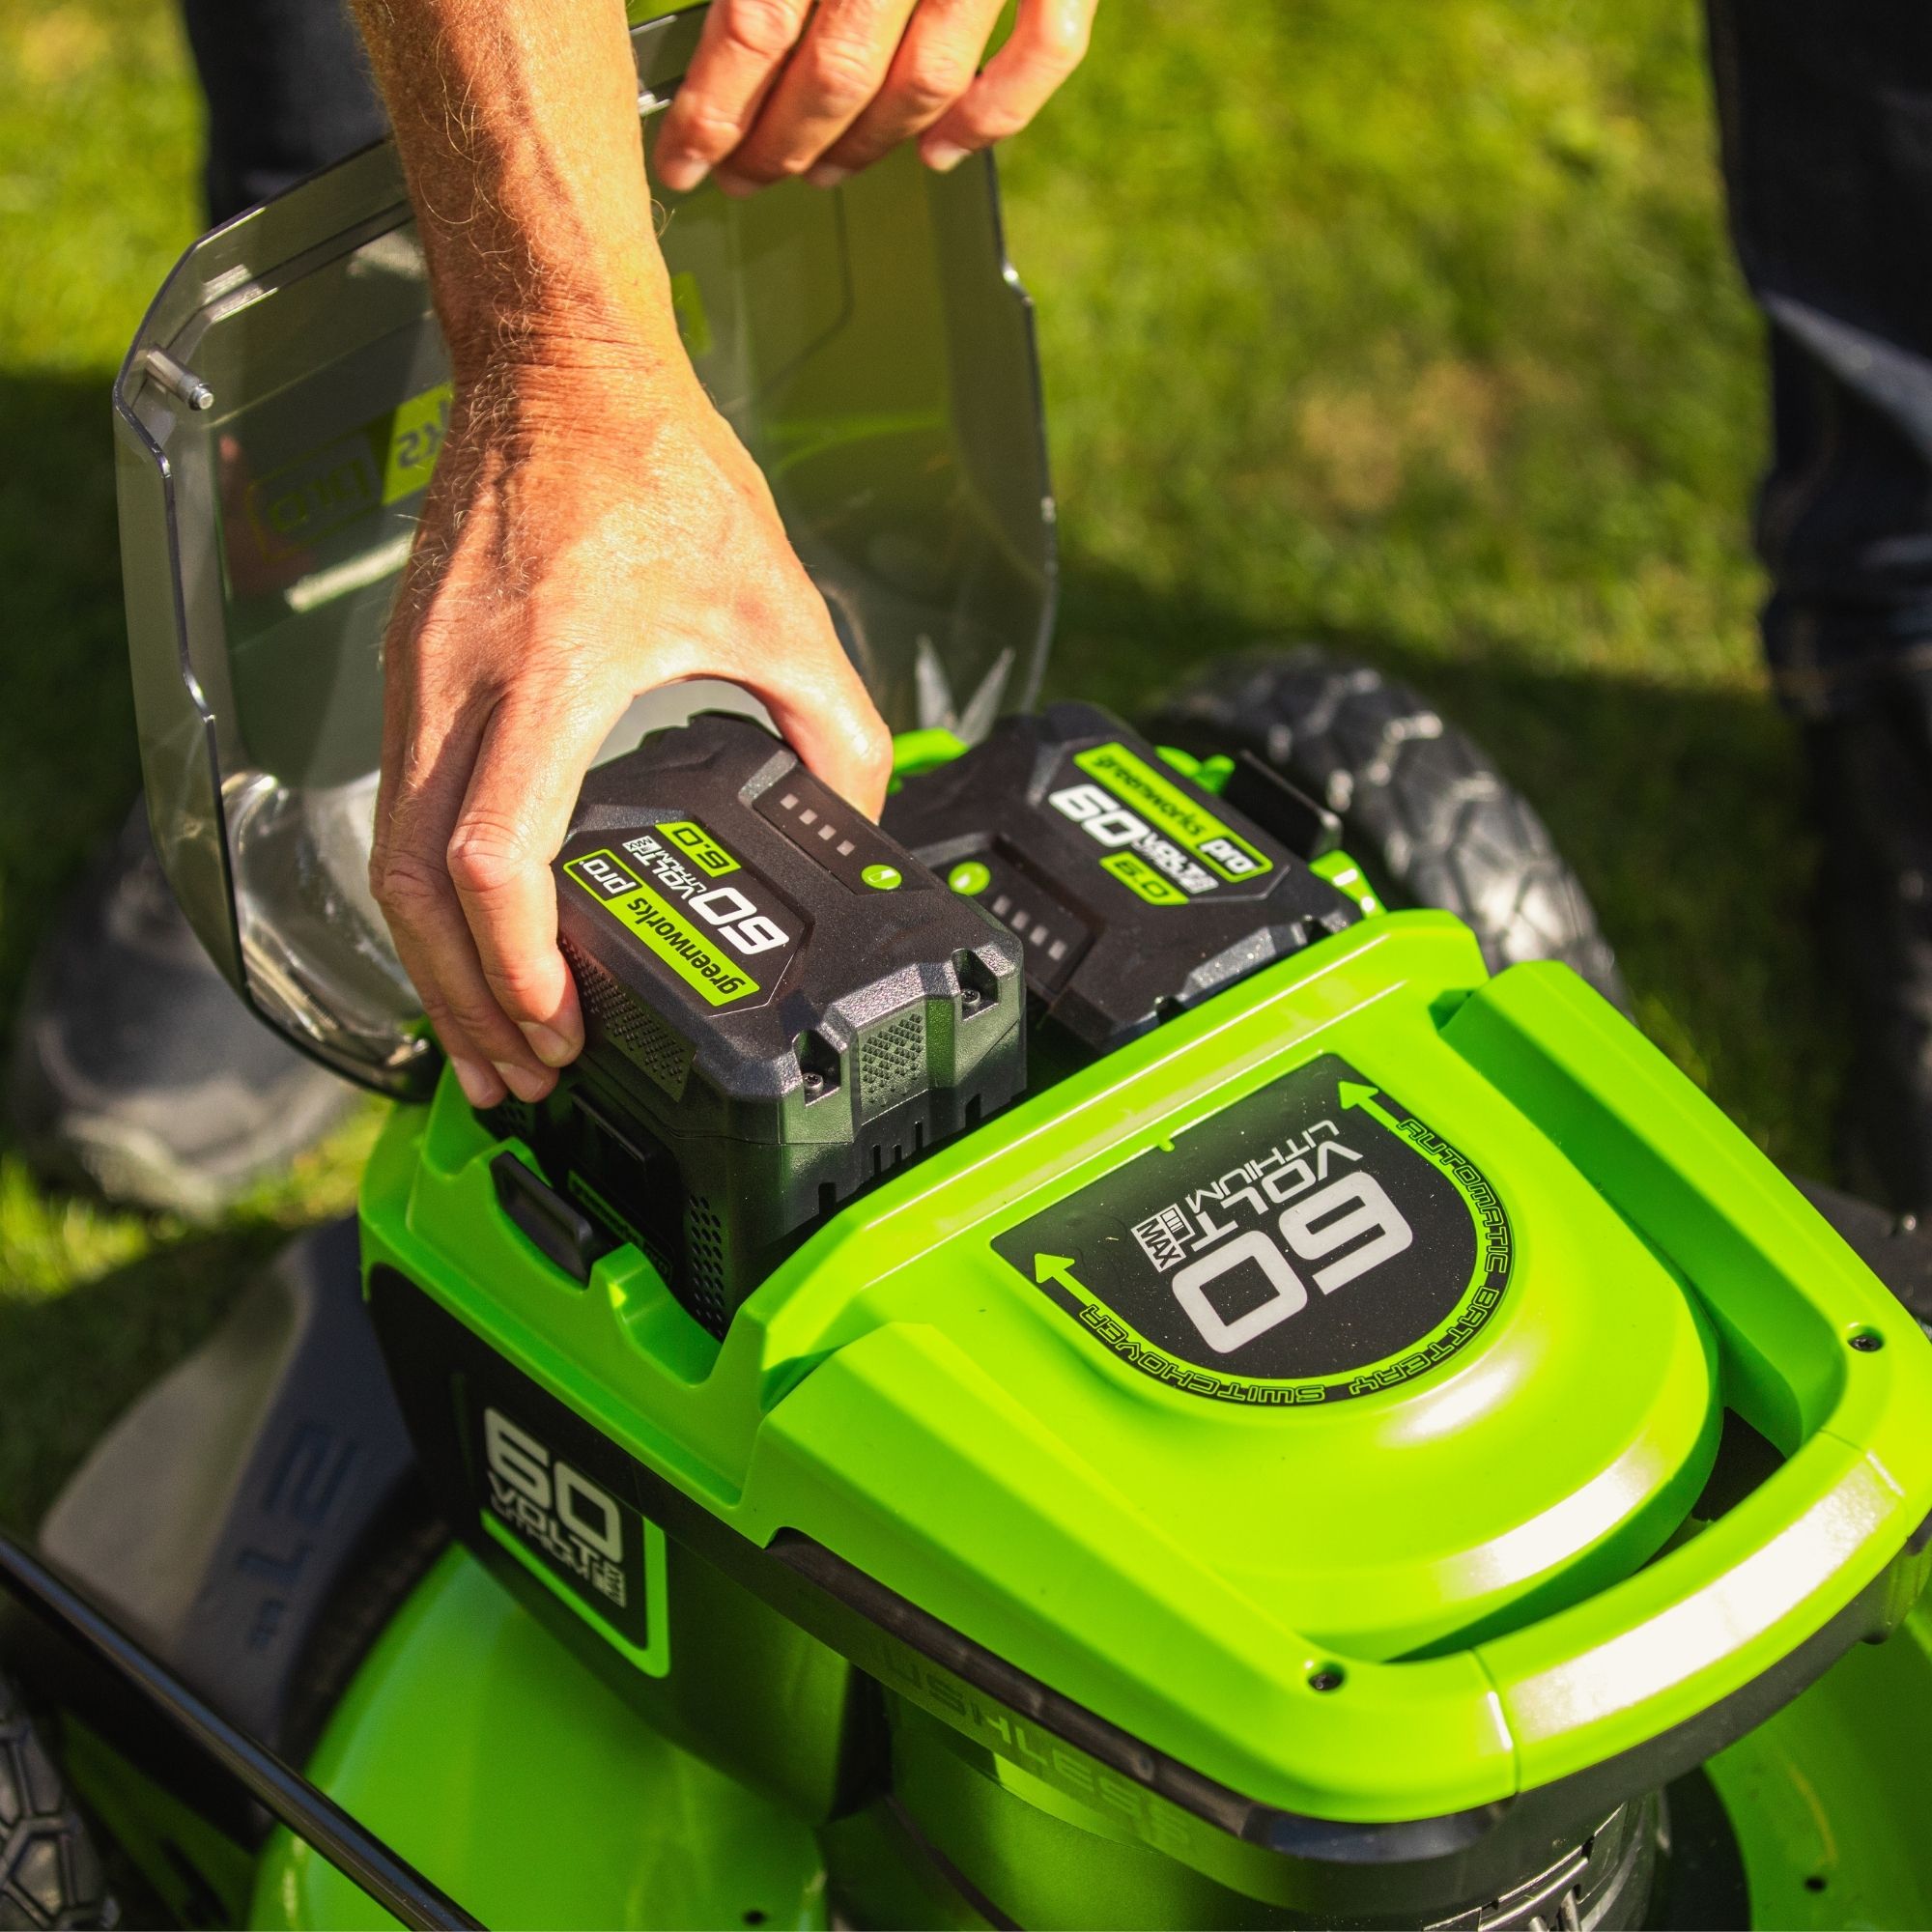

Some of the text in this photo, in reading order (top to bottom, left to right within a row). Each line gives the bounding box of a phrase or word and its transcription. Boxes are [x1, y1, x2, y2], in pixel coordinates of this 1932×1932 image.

[671, 828, 730, 869] 6.0
[1049, 783, 1151, 847] 60
[1093, 753, 1206, 836] greenworks
[1199, 838, 1256, 873] pro
[633, 852, 790, 955] 60 VOLT
[654, 849, 707, 894] LITHIUM
[580, 858, 747, 995] greenworks pro
[1185, 1119, 1340, 1212] LITHIUM
[1191, 1140, 1364, 1253] VOLT
[1397, 1119, 1510, 1274] AUTOMATIC
[1137, 1217, 1183, 1269] MAX
[1171, 1171, 1414, 1354] 60
[1078, 1304, 1326, 1404] SWITCHOVER
[1349, 1285, 1500, 1396] BATTERY
[484, 1406, 623, 1563] 60
[488, 1469, 601, 1572] VOLT
